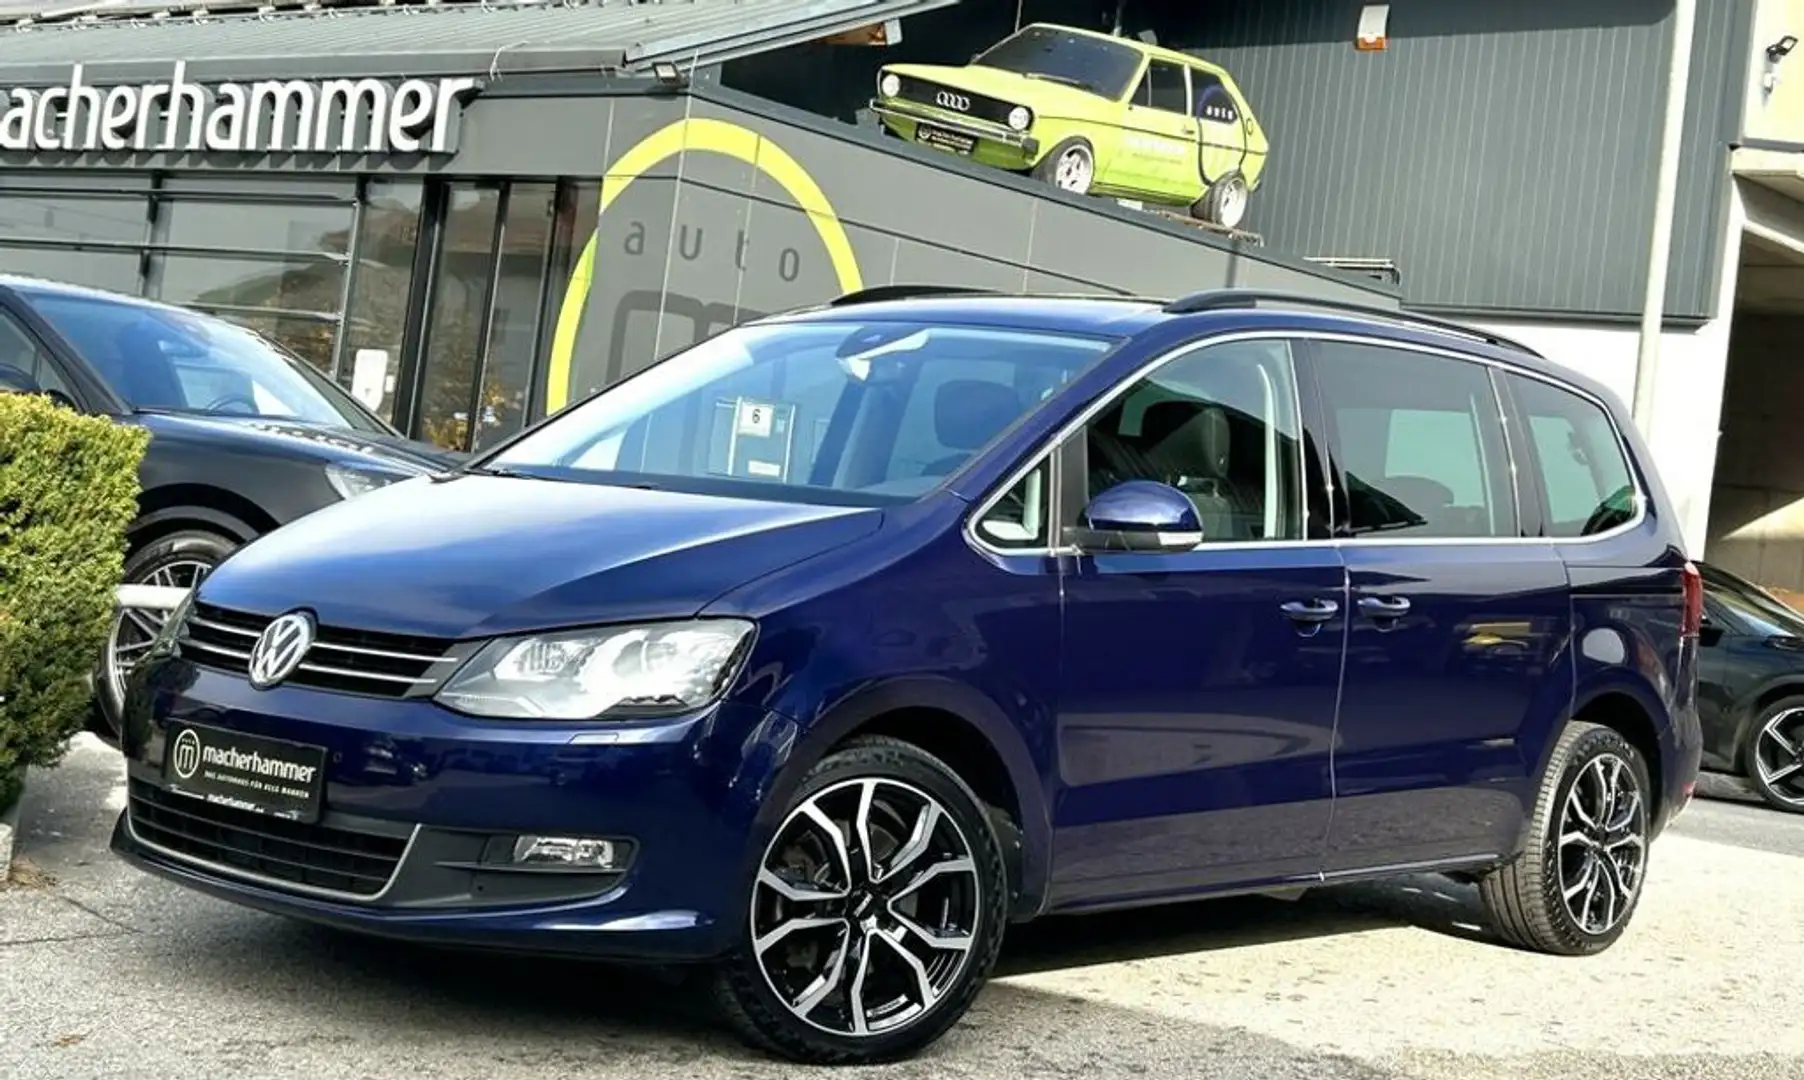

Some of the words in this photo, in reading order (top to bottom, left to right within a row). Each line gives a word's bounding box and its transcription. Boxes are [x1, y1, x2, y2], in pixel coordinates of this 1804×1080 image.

[624, 221, 800, 282] auto
[752, 408, 761, 424] 6
[202, 745, 317, 783] macherhammer
